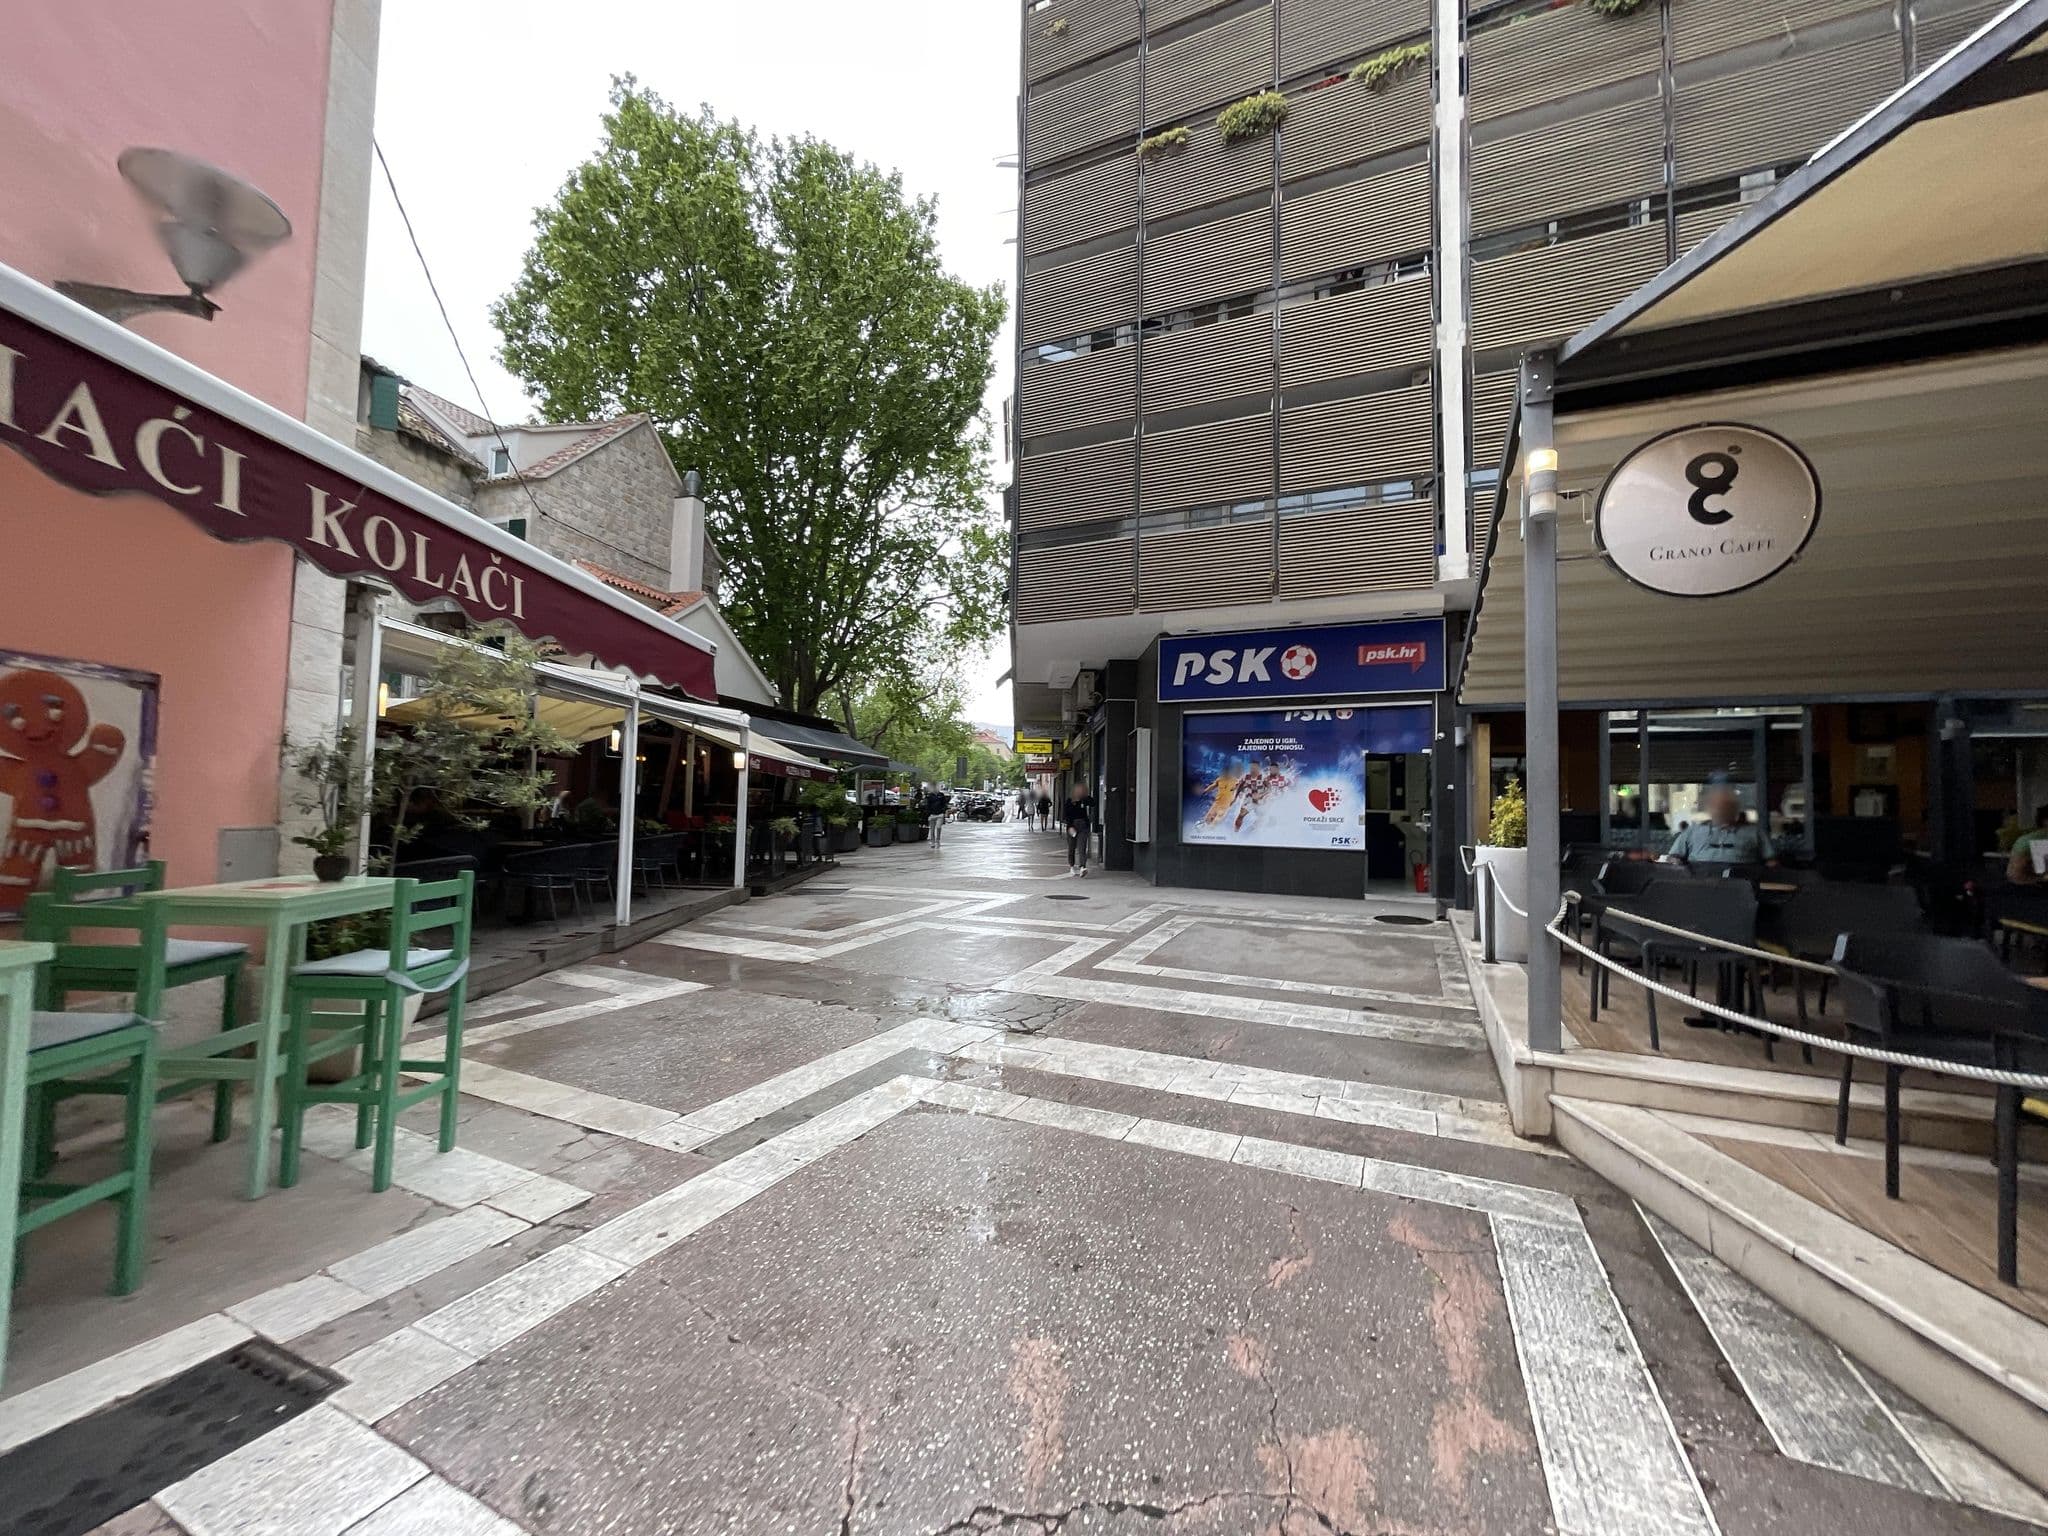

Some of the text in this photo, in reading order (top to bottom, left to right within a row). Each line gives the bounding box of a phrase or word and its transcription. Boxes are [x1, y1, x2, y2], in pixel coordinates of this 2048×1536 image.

[305, 483, 526, 620] KOLAČI
[1173, 647, 1277, 686] PSK
[1365, 646, 1418, 663] psk.hr
